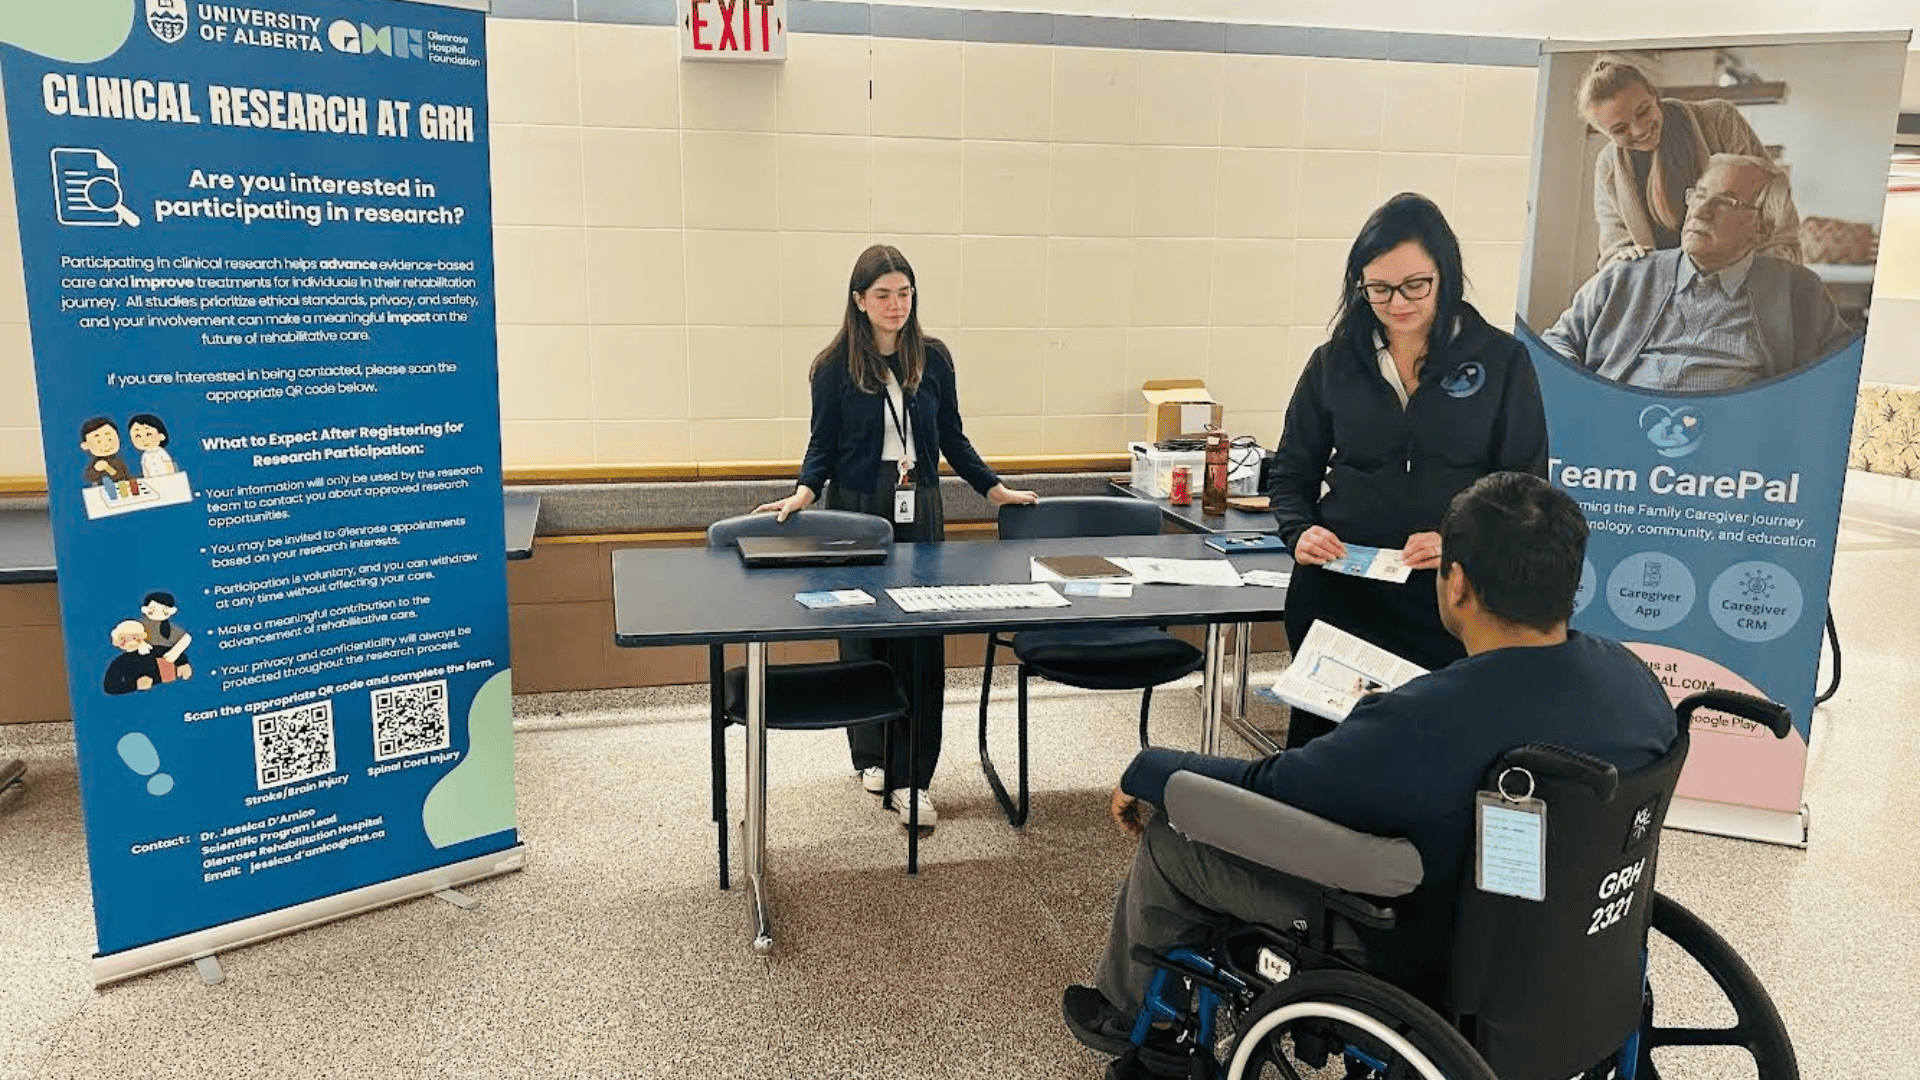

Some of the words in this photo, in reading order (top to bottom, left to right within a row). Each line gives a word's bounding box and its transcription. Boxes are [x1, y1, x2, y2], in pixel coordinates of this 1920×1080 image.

[198, 3, 321, 32] UNIVERSITY
[692, 0, 775, 52] EXIT
[200, 25, 227, 42] OF
[234, 28, 323, 52] ALBERTA
[427, 30, 469, 44] Glenrose
[428, 42, 467, 56] Hospital
[428, 52, 481, 67] Foundation
[42, 72, 200, 124] CLINICAL
[208, 84, 367, 135] RESEARCH
[377, 99, 410, 137] AT
[419, 103, 474, 142] GRH
[188, 169, 234, 189] Are
[239, 175, 285, 196] you
[290, 172, 410, 197] interested
[414, 178, 435, 197] in
[155, 197, 321, 226] participating
[326, 201, 349, 221] in
[354, 206, 464, 224] research?
[61, 256, 154, 272] Participating
[156, 256, 170, 268] in
[172, 256, 222, 269] clinical
[225, 257, 282, 269] research
[284, 258, 317, 272] helps
[319, 258, 377, 270] advance
[379, 259, 474, 271] evidence-based
[61, 278, 96, 288] care
[99, 276, 128, 288] and
[130, 275, 194, 291] improve
[196, 277, 271, 288] treatments
[273, 276, 289, 288] for
[292, 276, 357, 287] individuals
[360, 276, 372, 287] in
[374, 276, 400, 288] their
[403, 276, 475, 288] rehabilitation
[61, 297, 119, 311] journey.
[126, 295, 142, 307] All
[145, 295, 197, 307] studies
[200, 294, 256, 310] prioritize
[258, 294, 299, 307] ethical
[301, 294, 367, 306] standards,
[369, 294, 415, 308] privacy,
[417, 294, 440, 305] and
[442, 293, 478, 305] safety,
[79, 315, 109, 328] and
[112, 317, 144, 330] your
[147, 314, 235, 326] involvement
[237, 316, 263, 325] can
[265, 313, 300, 324] make
[302, 315, 311, 324] a
[313, 312, 385, 326] meaningful
[387, 311, 431, 325] impact
[432, 313, 446, 321] on
[449, 311, 467, 321] the
[107, 373, 115, 385] If
[118, 375, 145, 388] you
[148, 374, 173, 383] are
[175, 369, 245, 383] interested
[247, 369, 259, 380] in
[261, 368, 295, 381] being
[297, 364, 363, 377] contacted,
[365, 364, 406, 377] please
[408, 364, 436, 374] scan
[437, 362, 456, 372] the
[201, 436, 248, 450] What
[250, 435, 266, 446] to
[269, 430, 317, 447] Expect
[320, 427, 357, 440] After
[359, 422, 442, 440] Registering
[444, 421, 463, 433] for
[253, 448, 321, 466] Research
[323, 443, 424, 459] Participation:
[205, 488, 234, 498] Your
[237, 480, 304, 495] information
[306, 477, 324, 487] will
[326, 475, 350, 486] only
[352, 474, 367, 483] be
[369, 471, 398, 482] used
[401, 471, 415, 482] by
[417, 469, 435, 479] the
[437, 465, 482, 477] research
[1649, 465, 1800, 504] CarePal
[1579, 501, 1611, 515] ming
[1614, 502, 1635, 515] the
[1638, 504, 1681, 520] Family
[1685, 508, 1750, 524] Caregiver
[1751, 512, 1804, 530] journey
[210, 544, 234, 554] You
[237, 541, 264, 551] may
[267, 538, 282, 547] be
[285, 531, 321, 544] invited
[323, 530, 335, 538] to
[337, 525, 387, 537] Glenrose
[390, 517, 465, 534] appointments
[1587, 519, 1634, 535] nology,
[1638, 524, 1715, 542] community,
[1718, 530, 1744, 542] and
[1747, 532, 1816, 547] education
[214, 577, 289, 595] Participation
[292, 574, 300, 583] is
[302, 567, 356, 581] voluntary,
[358, 562, 380, 573] and
[383, 562, 403, 573] you
[406, 559, 428, 568] can
[430, 554, 477, 565] withdraw
[1619, 587, 1681, 602] Caregiver
[1722, 599, 1787, 616] Caregiver
[218, 624, 250, 635] Make
[253, 622, 262, 630] a
[264, 608, 327, 628] meaningful
[329, 600, 396, 616] contribution
[398, 598, 409, 606] to
[412, 596, 430, 605] the
[1636, 605, 1661, 618] App
[1737, 618, 1767, 630] CRM
[1664, 662, 1677, 673] at
[184, 709, 218, 721] Scan
[220, 705, 242, 715] the
[244, 690, 316, 713] appropriate
[318, 685, 333, 696] QR
[335, 679, 364, 692] code
[365, 674, 389, 686] and
[390, 667, 444, 682] complete
[446, 664, 464, 673] the
[466, 659, 494, 670] form.
[1660, 676, 1715, 691] AL.COM
[1690, 714, 1730, 728] oogle
[1732, 716, 1758, 732] Play
[367, 761, 401, 777] Spinal
[403, 755, 428, 768] Cord
[430, 751, 459, 763] Injury
[245, 782, 316, 806] Stroke/Brain
[318, 774, 348, 788] Injury
[200, 831, 218, 841] Dr.
[220, 820, 265, 836] Jessica
[267, 808, 315, 826] D'Amico
[201, 835, 258, 855] Scientific
[260, 823, 310, 842] Program
[311, 813, 337, 828] Lead
[131, 836, 184, 854] Contact
[202, 850, 256, 868] Glenrose
[259, 829, 337, 855] Rehabilitation
[338, 816, 382, 834] Hospital
[204, 866, 241, 882] Email:
[250, 830, 385, 874] jessica.d'amico@ahs.ca
[1598, 857, 1646, 900] GRH
[1586, 890, 1634, 936] 2321
